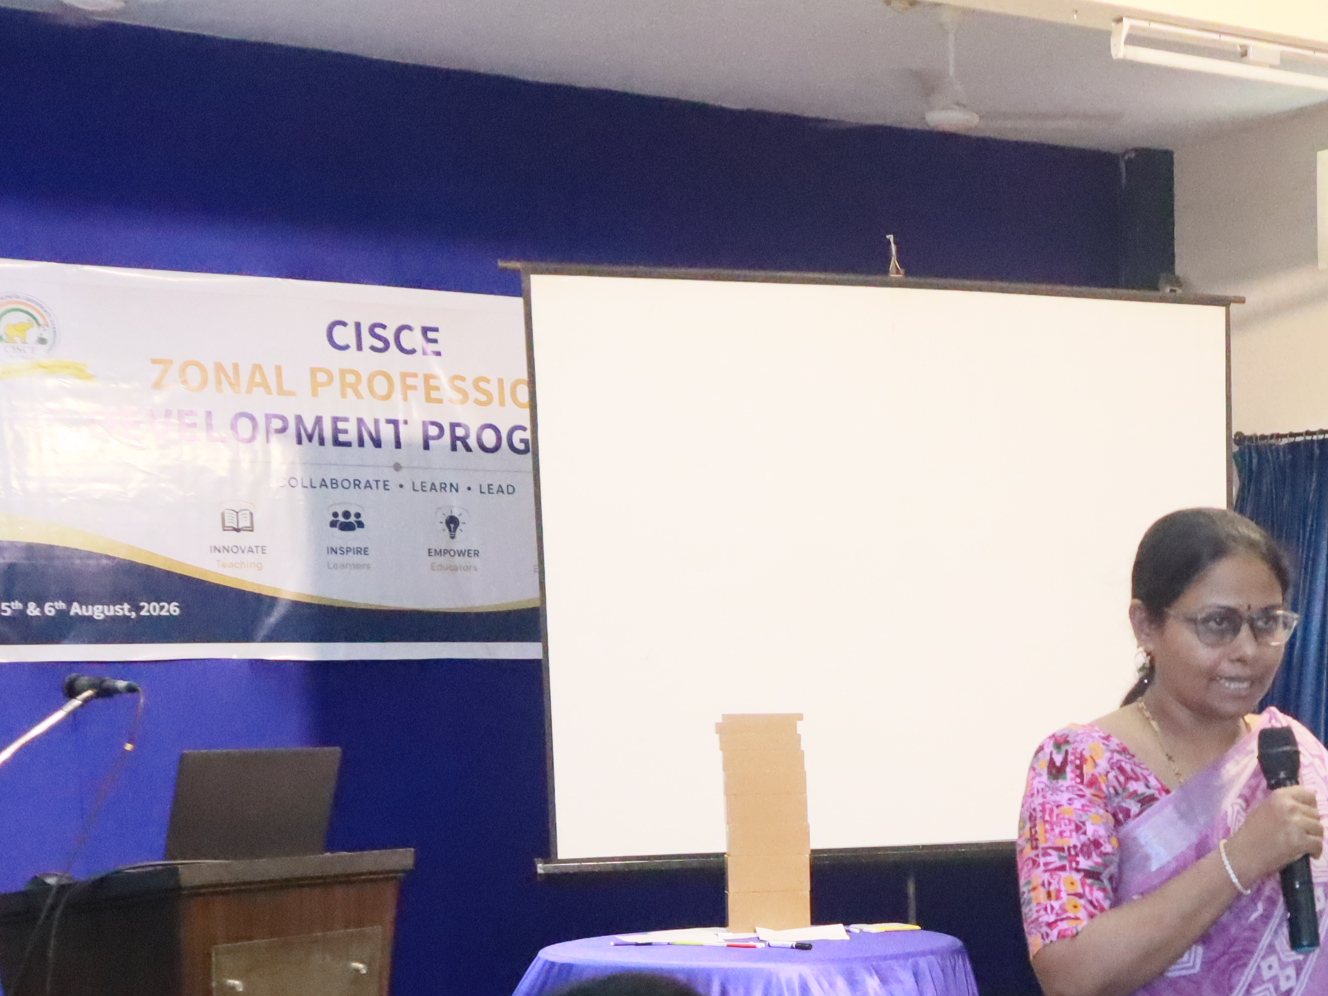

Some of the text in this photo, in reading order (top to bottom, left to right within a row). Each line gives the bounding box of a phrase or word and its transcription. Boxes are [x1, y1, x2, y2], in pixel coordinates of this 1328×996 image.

[325, 319, 443, 357] CISCE
[149, 358, 297, 397] ZONAL
[411, 481, 460, 495] LEARN
[479, 483, 516, 496] LEAD
[209, 545, 267, 555] INNOVATE
[326, 546, 370, 556] INSPIRE
[427, 548, 480, 558] EMPOWER
[215, 559, 263, 571] Teaching
[326, 561, 371, 571] Learners
[430, 561, 478, 573] Educators
[1, 601, 180, 620] 5th & 6th August, 2026
